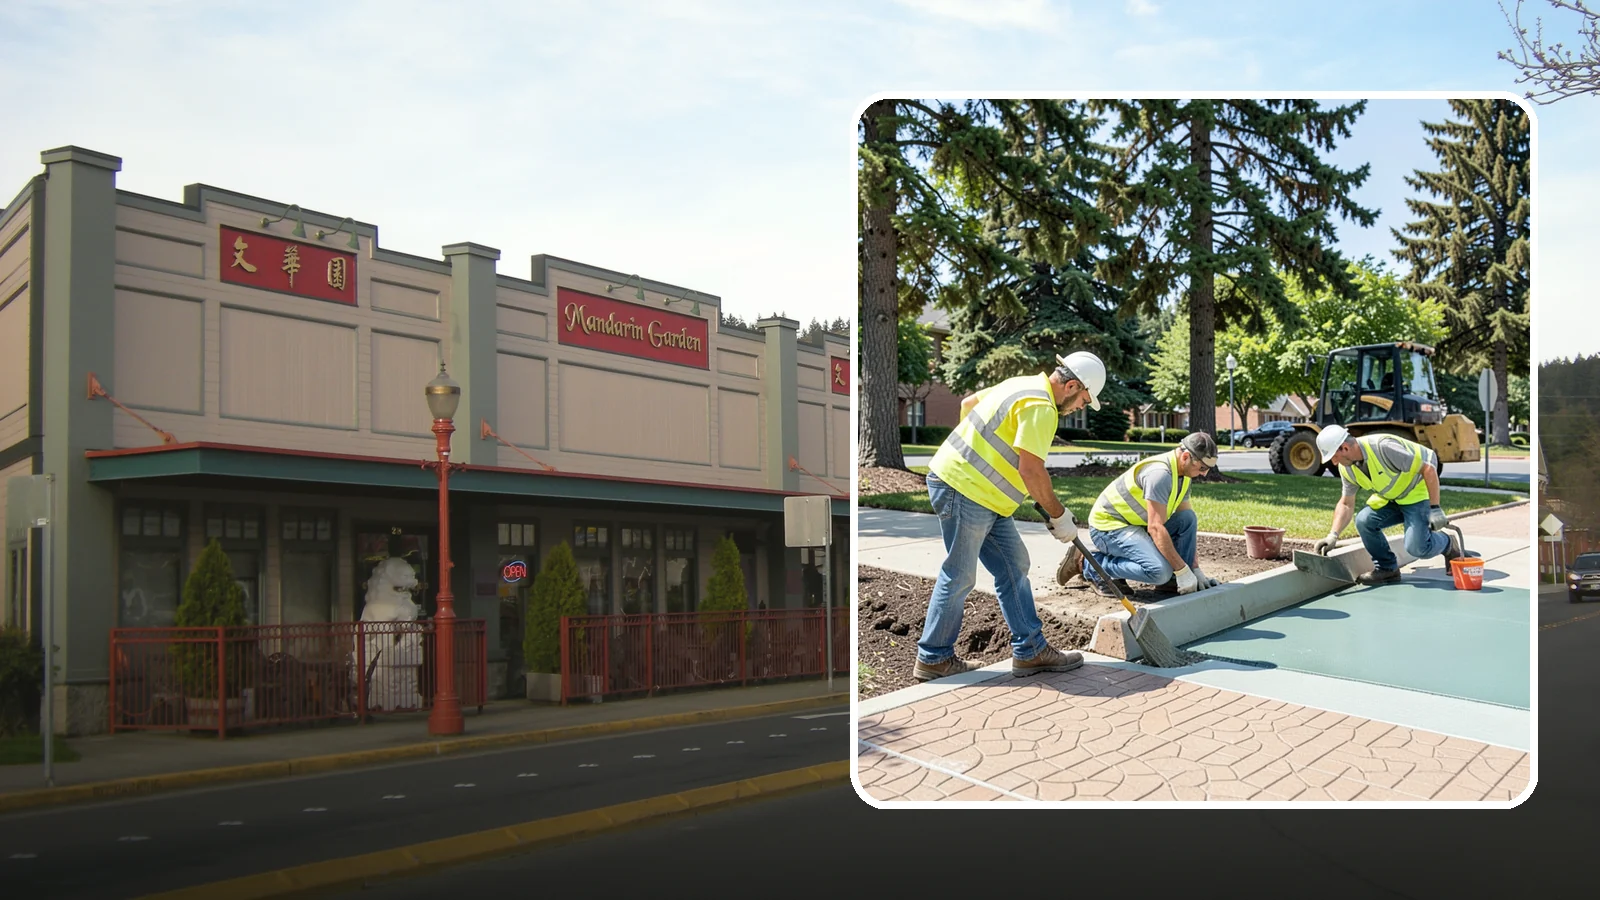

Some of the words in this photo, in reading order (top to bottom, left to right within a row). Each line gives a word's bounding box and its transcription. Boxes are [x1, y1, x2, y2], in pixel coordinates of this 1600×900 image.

[231, 235, 346, 291] 文華園
[564, 302, 644, 341] Mandarin
[648, 320, 701, 352] Garden
[503, 565, 527, 578] OPEN
